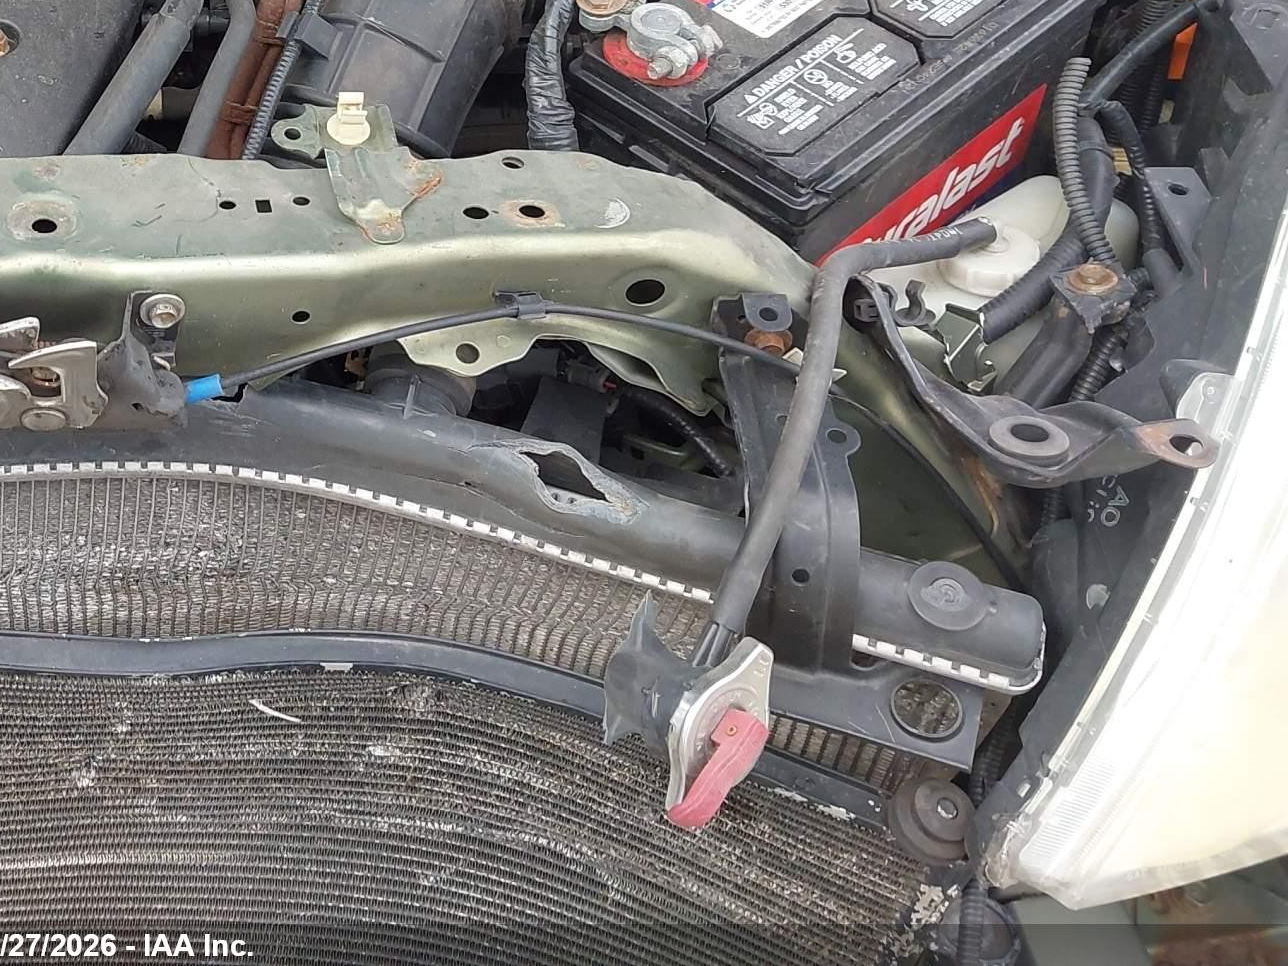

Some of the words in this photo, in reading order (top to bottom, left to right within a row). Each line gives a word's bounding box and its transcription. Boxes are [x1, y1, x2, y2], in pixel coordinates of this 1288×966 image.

[752, 64, 800, 97] DANGER
[802, 35, 843, 63] POISON
[862, 117, 1025, 243] ralast
